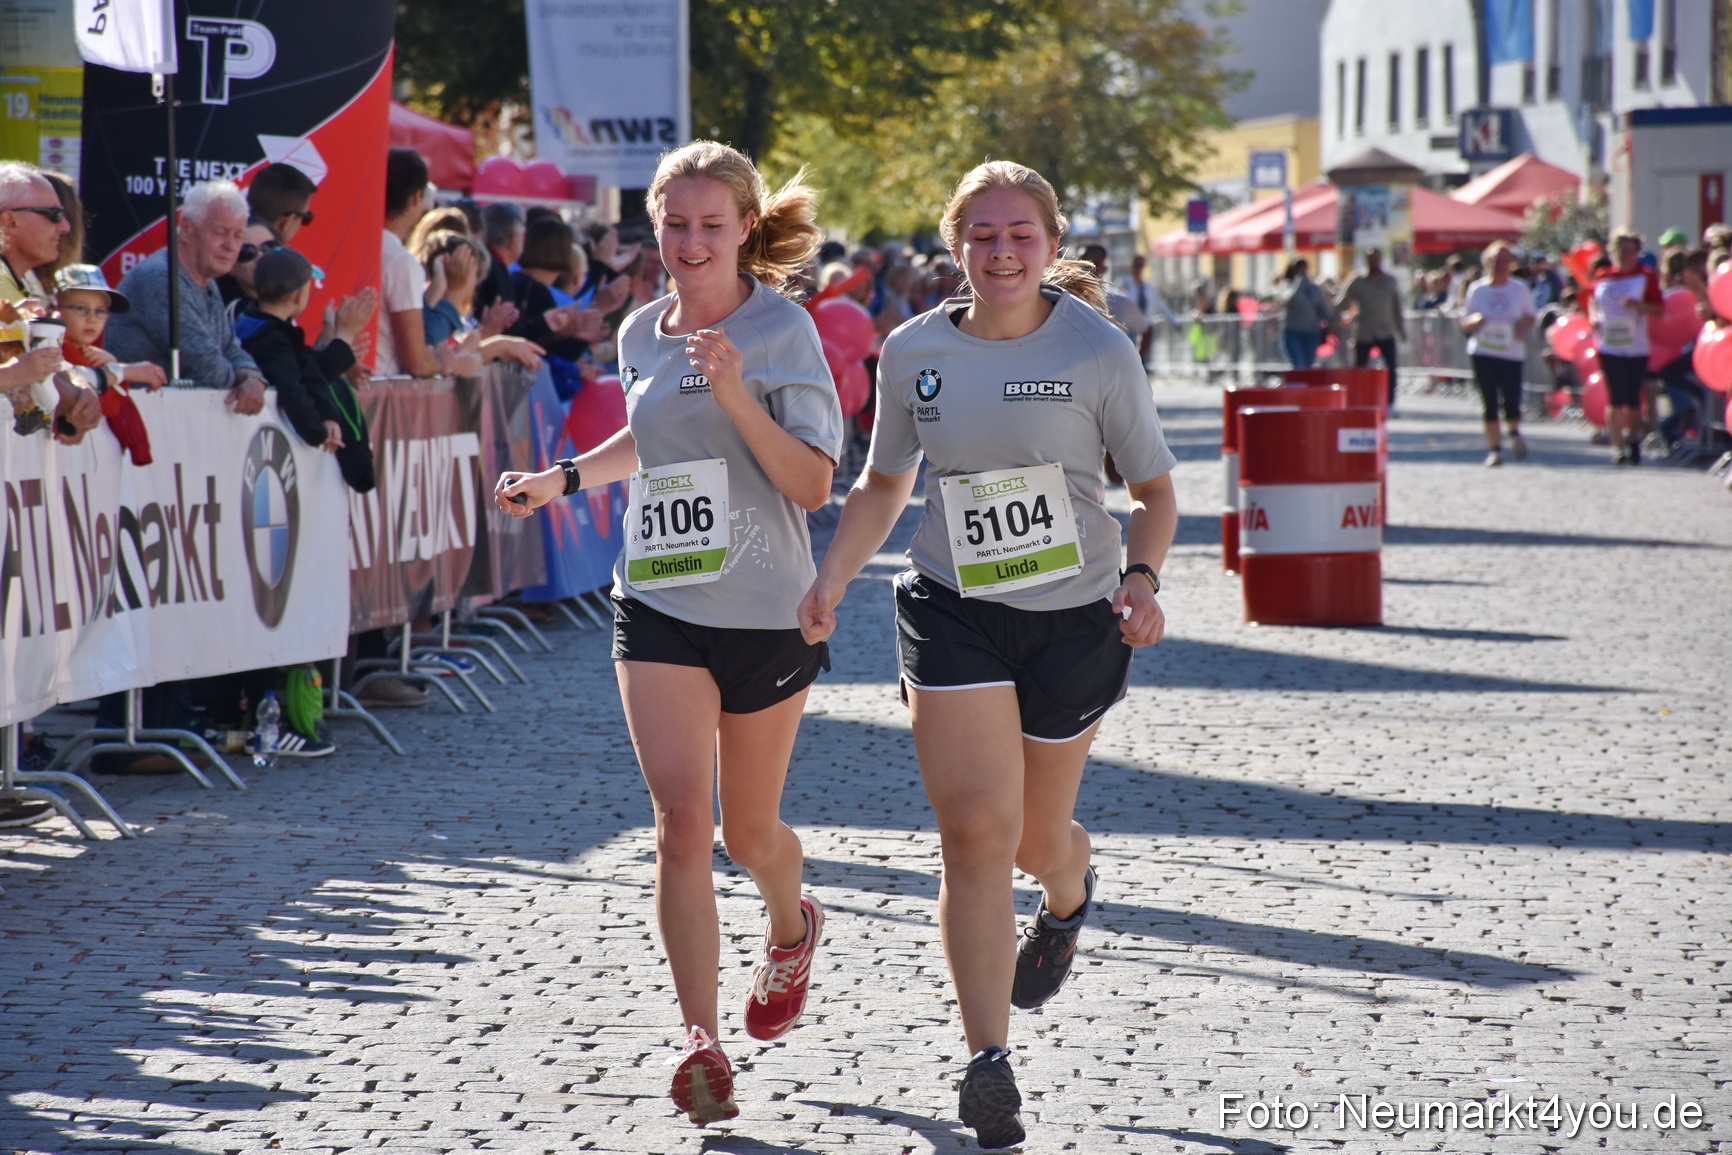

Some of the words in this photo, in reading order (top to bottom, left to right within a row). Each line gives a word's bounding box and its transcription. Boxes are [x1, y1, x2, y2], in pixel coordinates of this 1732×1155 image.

[4, 92, 36, 119] 19.
[154, 157, 191, 178] TE
[194, 160, 249, 181] NEXT
[126, 176, 154, 195] 100
[680, 374, 709, 389] BO
[1004, 381, 1073, 397] BOCK
[917, 406, 941, 416] PARTL
[649, 475, 693, 492] BOCK
[971, 476, 1027, 498] BOCK
[641, 496, 714, 540] 5106
[964, 494, 1054, 546] 5104
[645, 543, 665, 553] PARTL
[666, 540, 699, 550] Neumarkt
[729, 538, 751, 568] September
[976, 549, 1002, 558] PARTL
[1003, 539, 1041, 554] Neumarkt
[651, 556, 702, 576] Christin
[996, 559, 1039, 579] Linda
